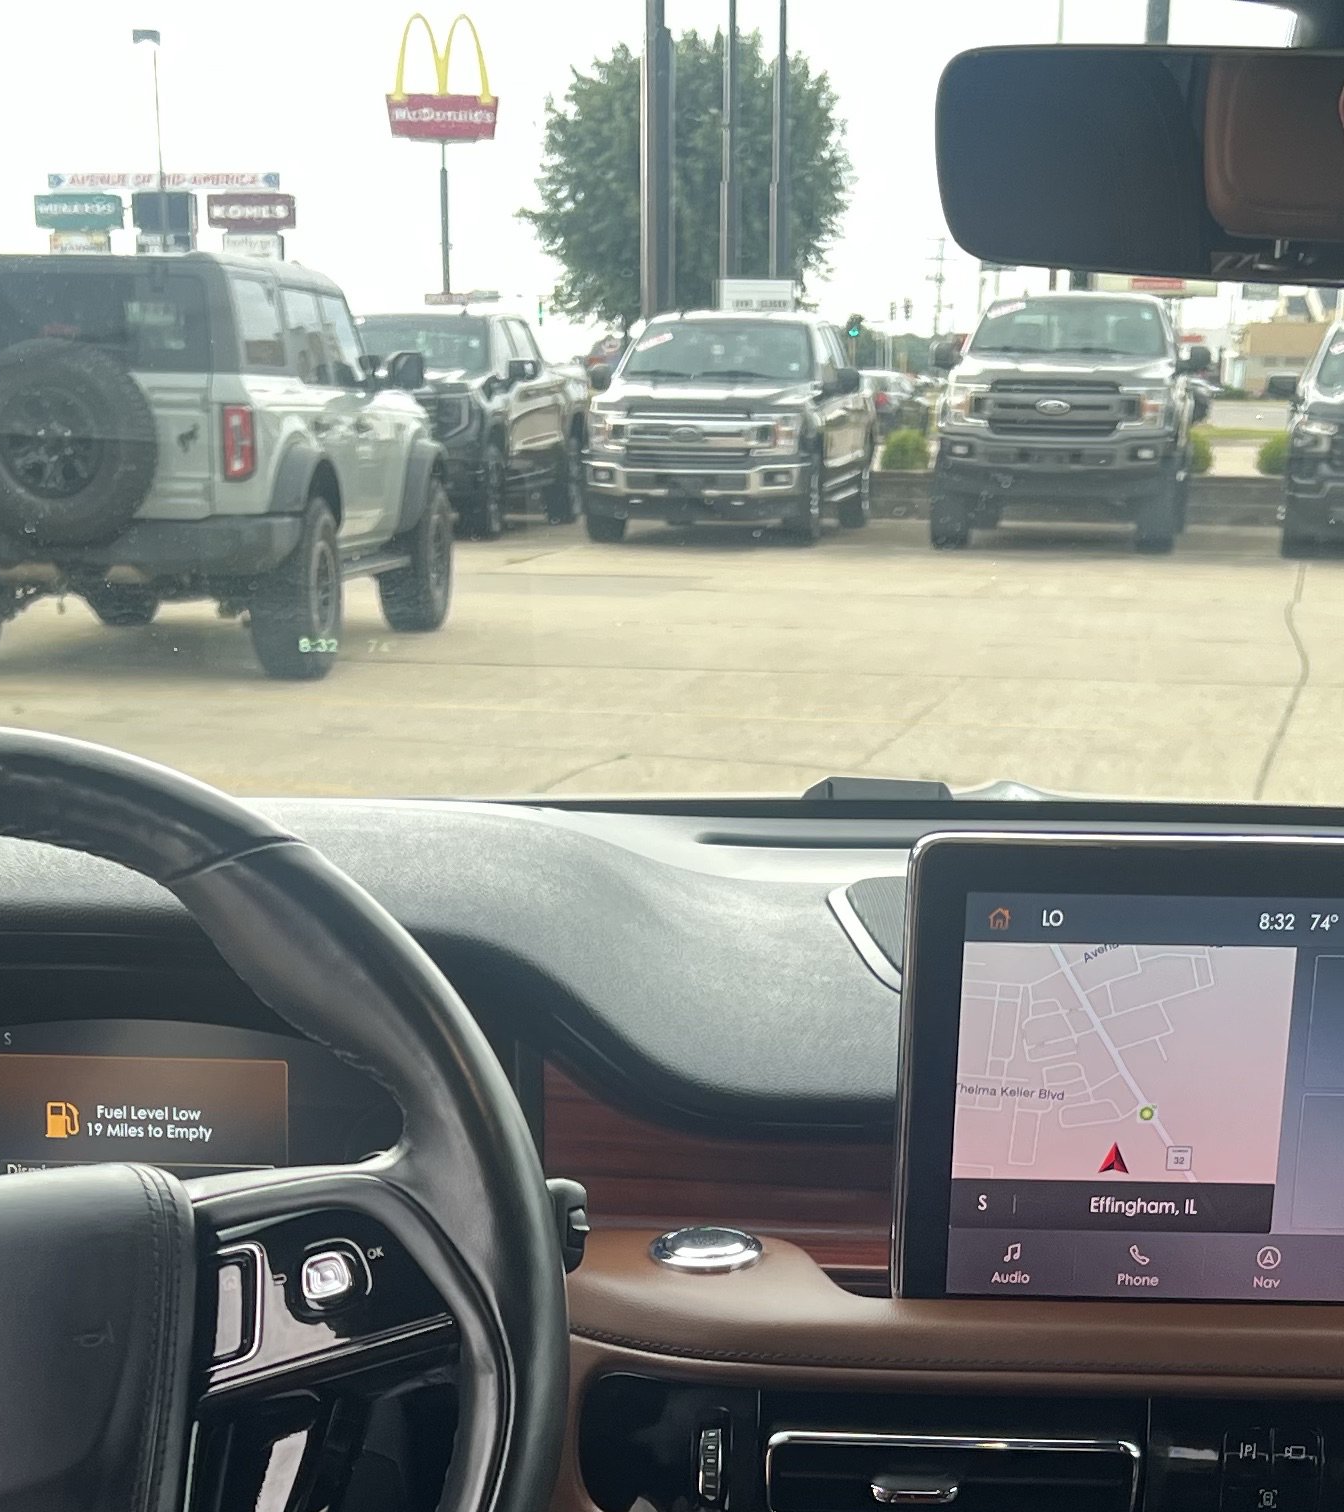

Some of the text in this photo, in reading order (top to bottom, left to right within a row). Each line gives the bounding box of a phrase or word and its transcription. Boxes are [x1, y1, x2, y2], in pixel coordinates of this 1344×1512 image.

[1042, 909, 1064, 928] LO
[1258, 913, 1296, 931] 8:32
[3, 1032, 13, 1046] S
[1038, 1088, 1065, 1101] Blvd
[96, 1105, 202, 1122] Fuel Level Low
[86, 1122, 213, 1142] 19 Miles to Empty
[1173, 1156, 1185, 1165] 32
[977, 1194, 1198, 1217] S Effingham, IL
[366, 1246, 386, 1260] OK
[991, 1270, 1030, 1284] Audio
[1116, 1272, 1160, 1287] Phone
[1252, 1275, 1281, 1289] Nav
